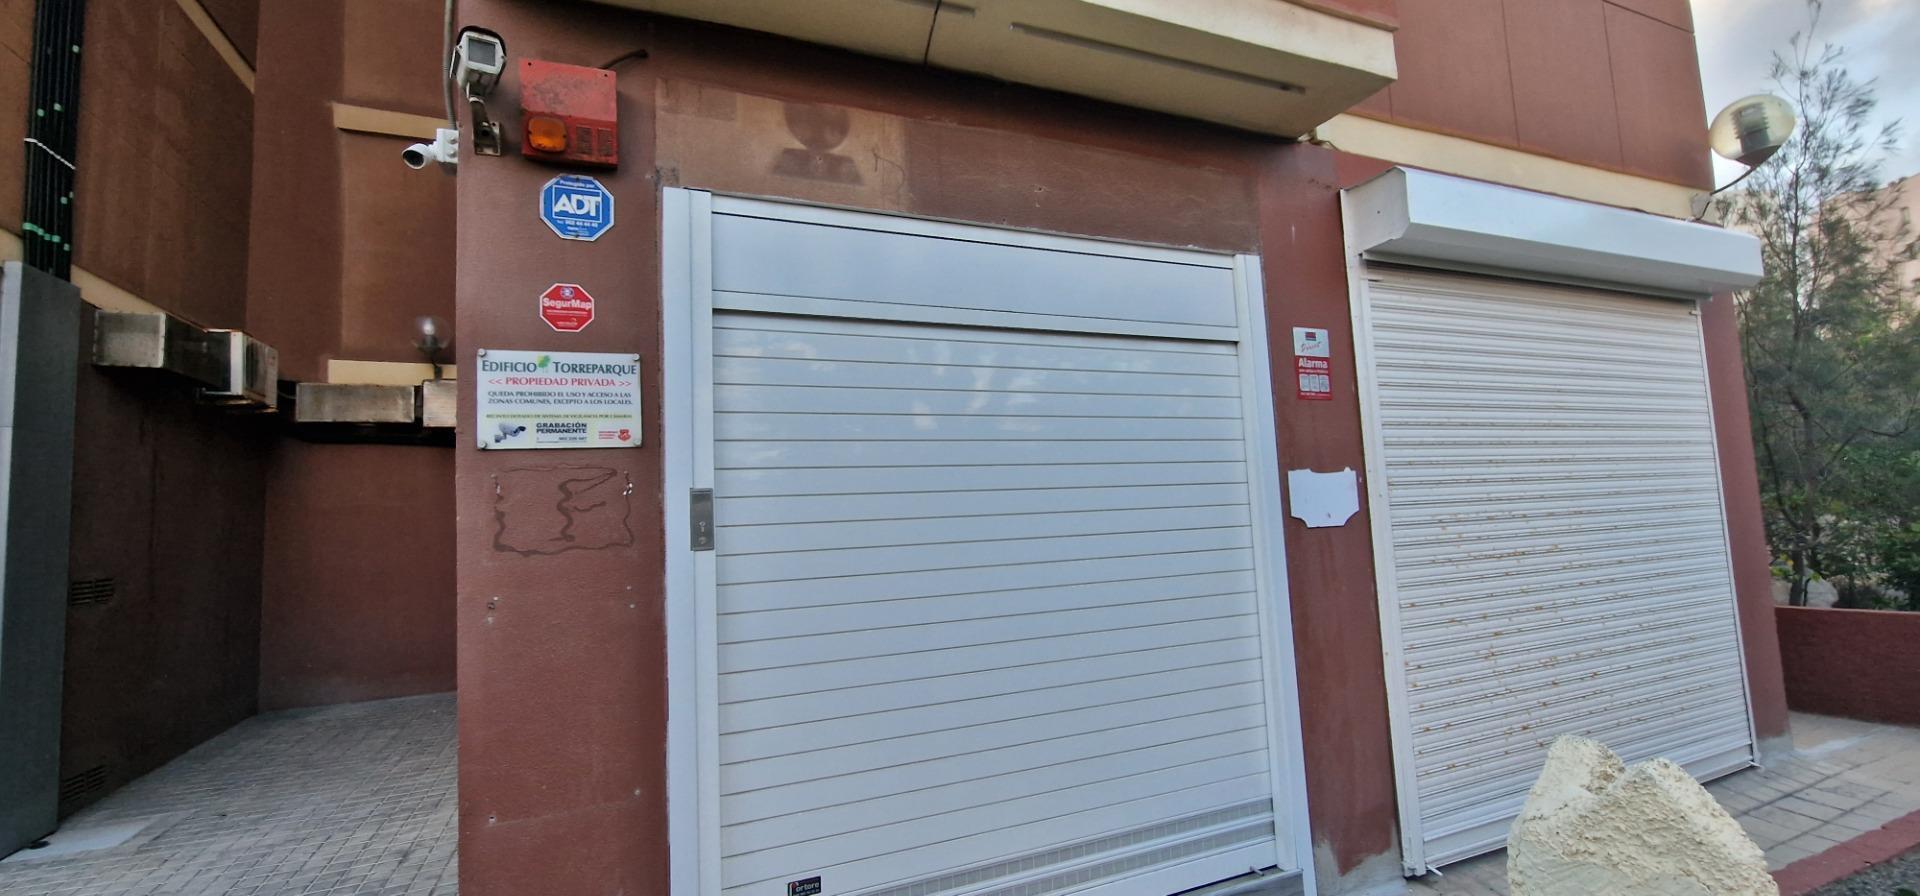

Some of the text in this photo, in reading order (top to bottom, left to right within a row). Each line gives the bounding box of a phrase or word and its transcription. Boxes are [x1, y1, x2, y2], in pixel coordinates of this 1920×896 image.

[554, 193, 601, 217] ADT
[542, 297, 592, 311] SegurMap
[482, 360, 637, 376] EDIFICIO TORREPARQUE
[1298, 357, 1328, 369] Alarma
[505, 376, 568, 386] PROPIEDAD
[571, 377, 616, 387] PRIVADA
